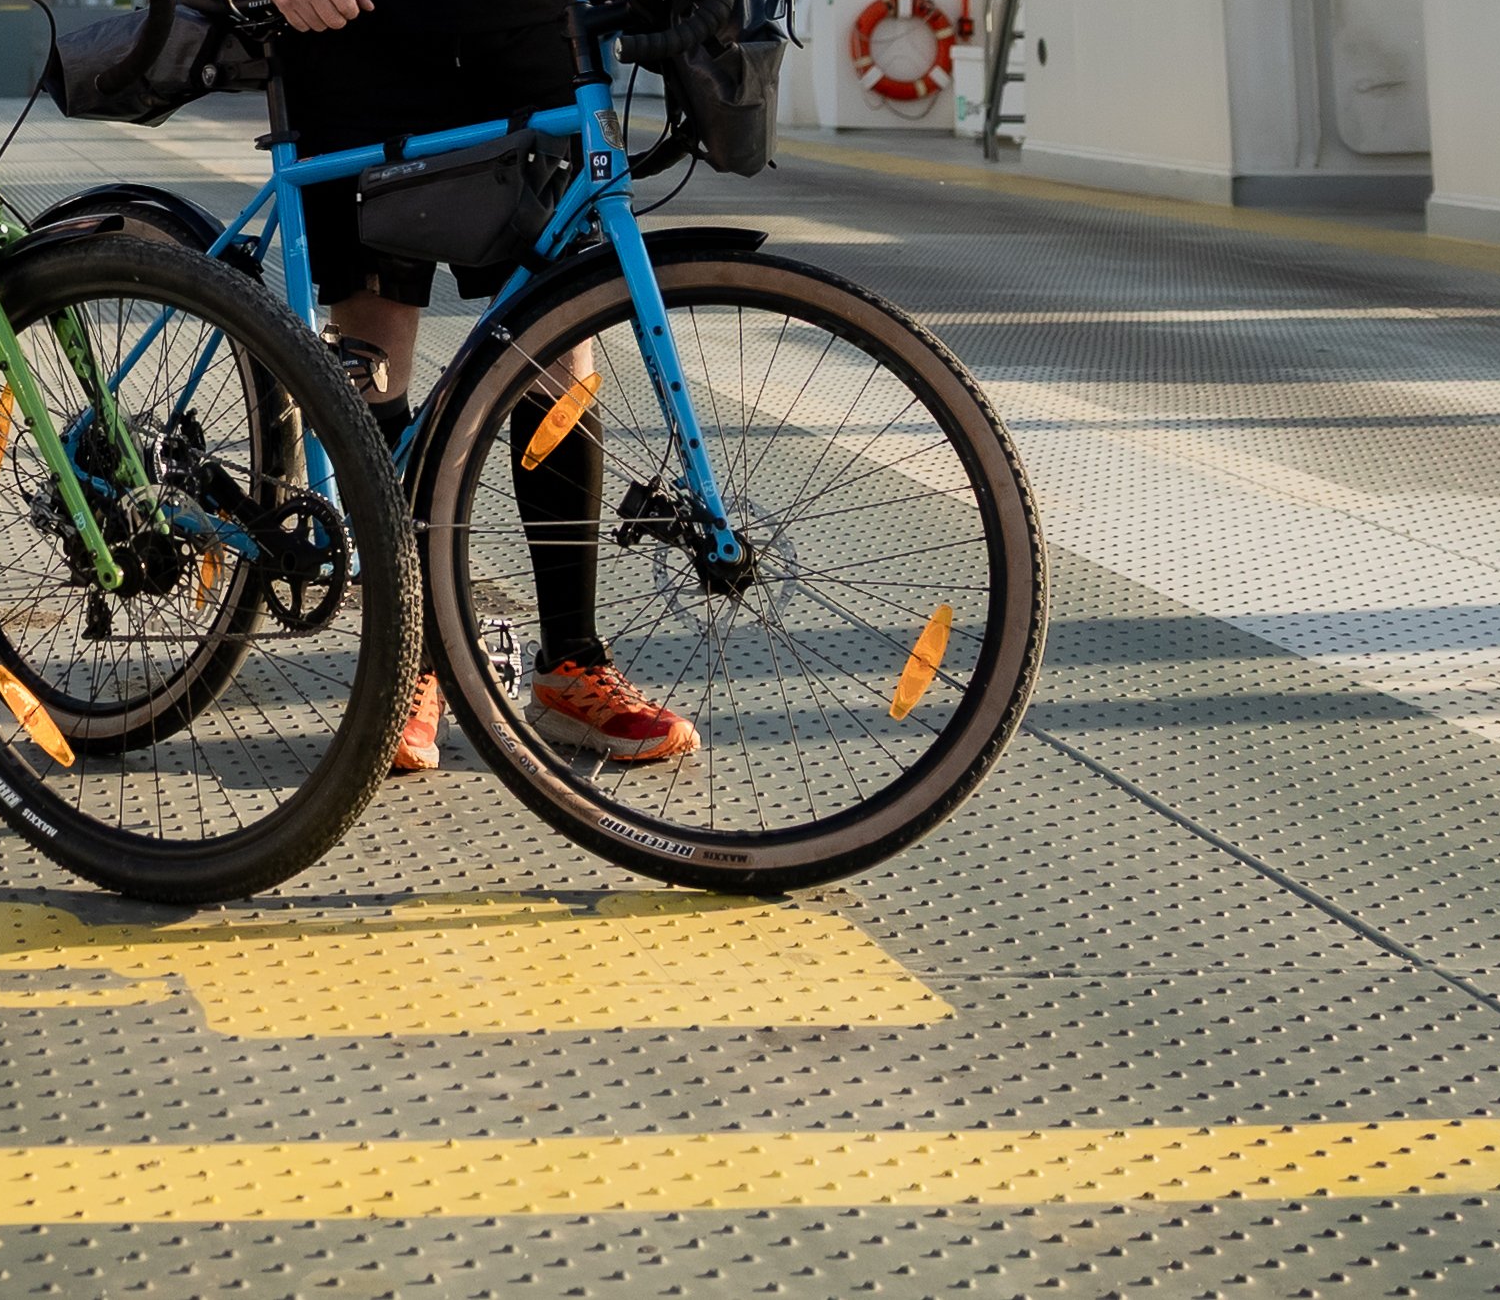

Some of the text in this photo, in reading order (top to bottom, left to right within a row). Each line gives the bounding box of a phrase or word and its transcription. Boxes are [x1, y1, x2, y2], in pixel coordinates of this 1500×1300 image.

[592, 155, 608, 167] 60
[596, 169, 605, 178] M
[21, 806, 59, 838] MAXXIS
[598, 814, 695, 859] RECEPTOR
[702, 850, 749, 864] MAXXIS
